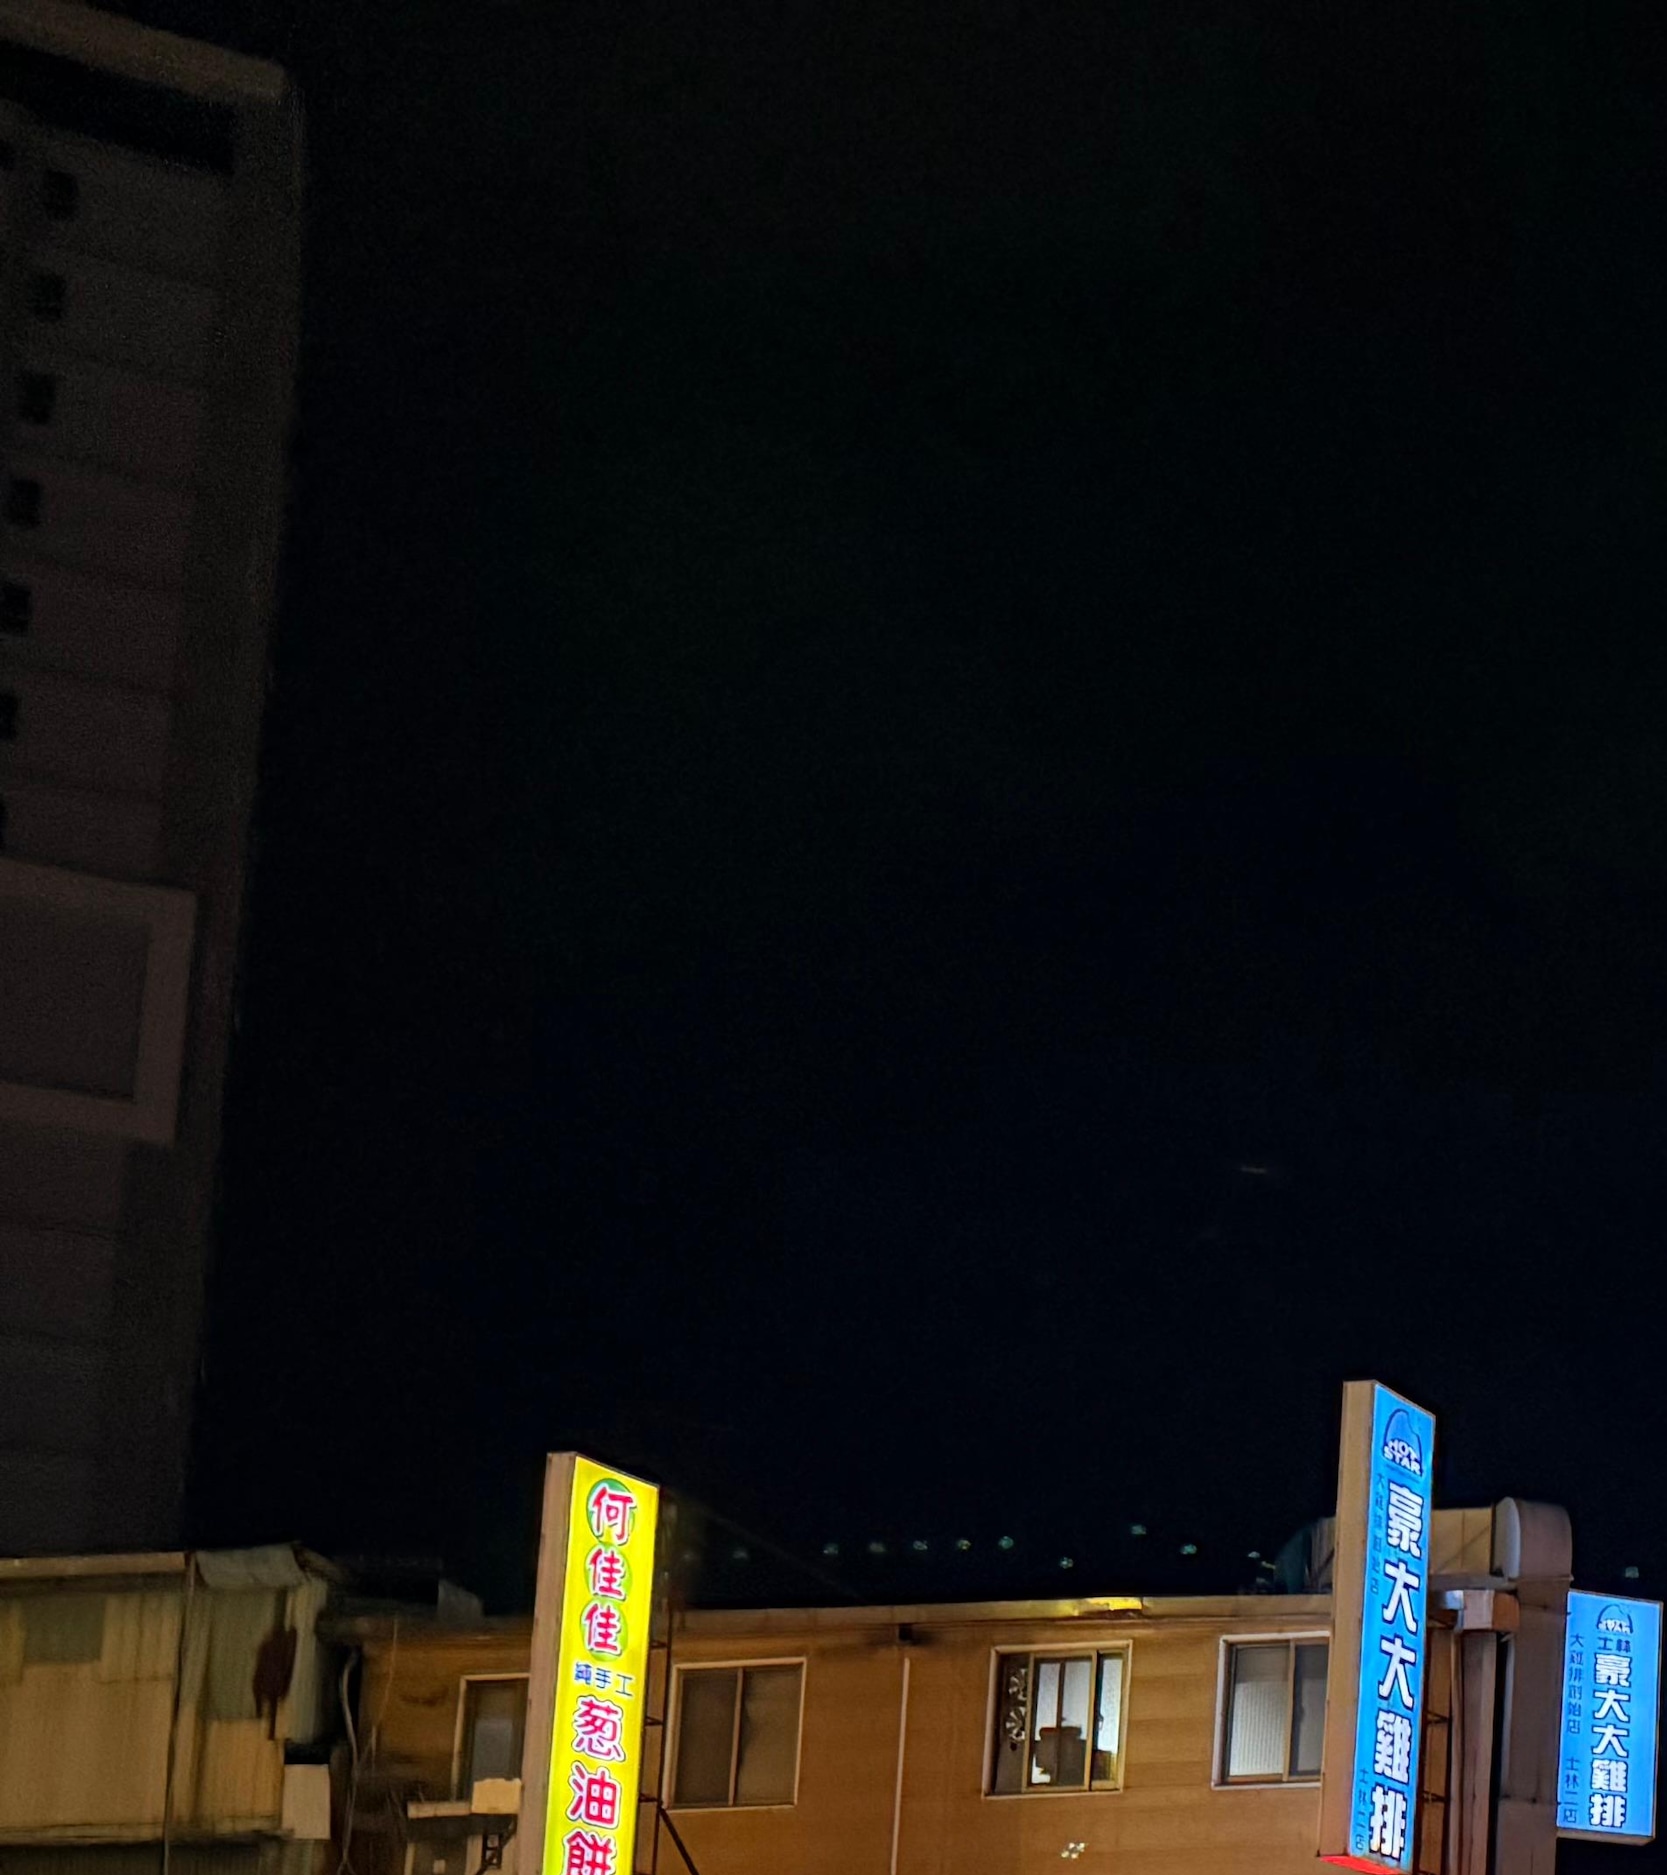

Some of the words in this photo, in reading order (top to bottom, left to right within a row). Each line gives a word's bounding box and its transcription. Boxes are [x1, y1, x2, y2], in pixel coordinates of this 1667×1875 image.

[1384, 1446, 1422, 1475] STAR
[1387, 1438, 1421, 1460] HOT
[585, 1486, 635, 1653] 何佳佳
[573, 1662, 634, 1698] 純手工
[1368, 1479, 1424, 1859] 豪大大雞排
[1589, 1653, 1633, 1828] 豪大大雞排
